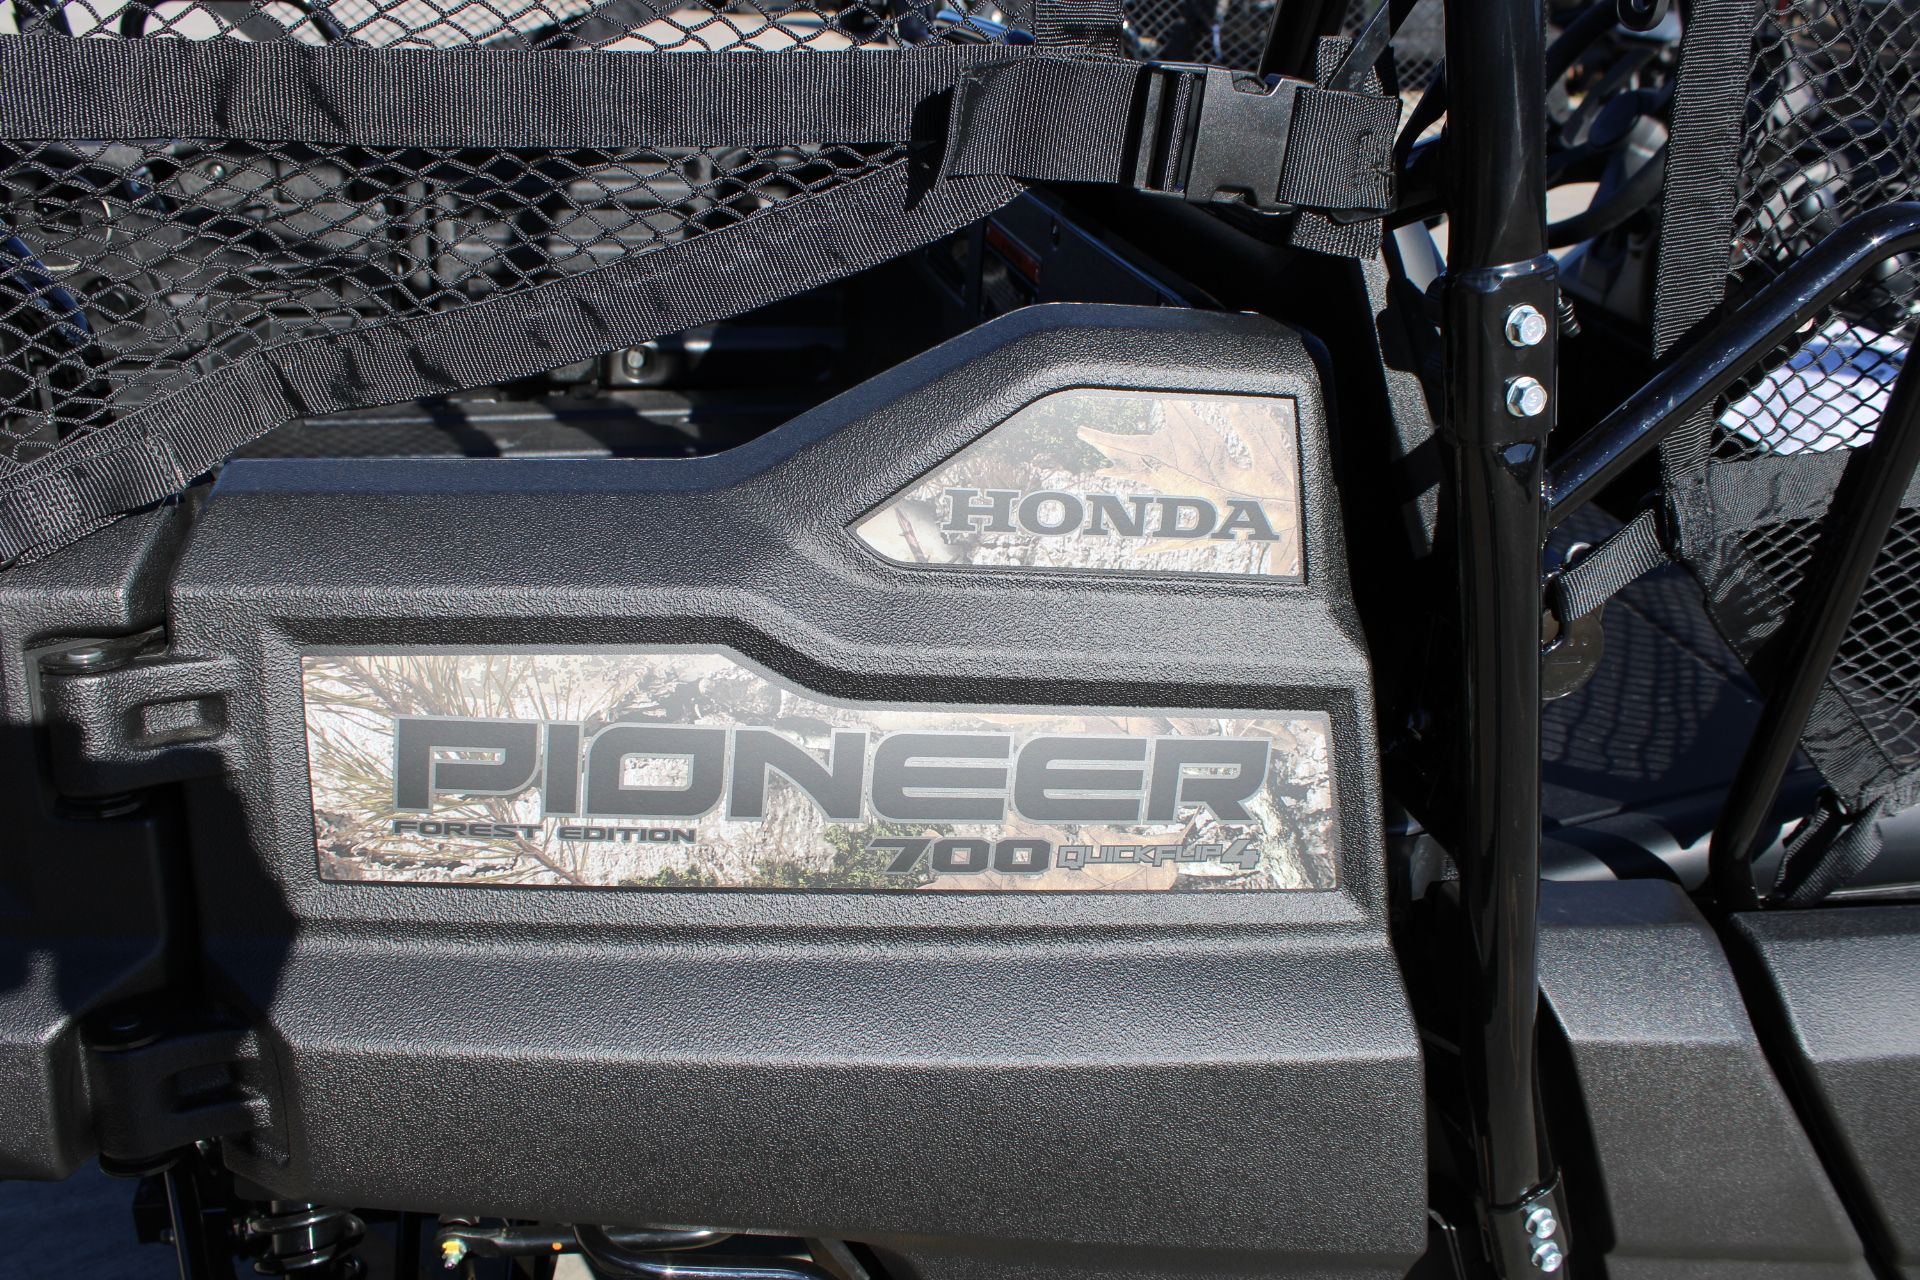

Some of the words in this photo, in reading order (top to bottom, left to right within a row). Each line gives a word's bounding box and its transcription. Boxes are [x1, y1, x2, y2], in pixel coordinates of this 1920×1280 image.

[942, 487, 1280, 542] HONDA
[393, 715, 1272, 825] PIONEER
[392, 819, 542, 841] FOREST
[557, 824, 697, 844] EDITION
[864, 836, 1053, 875] 700
